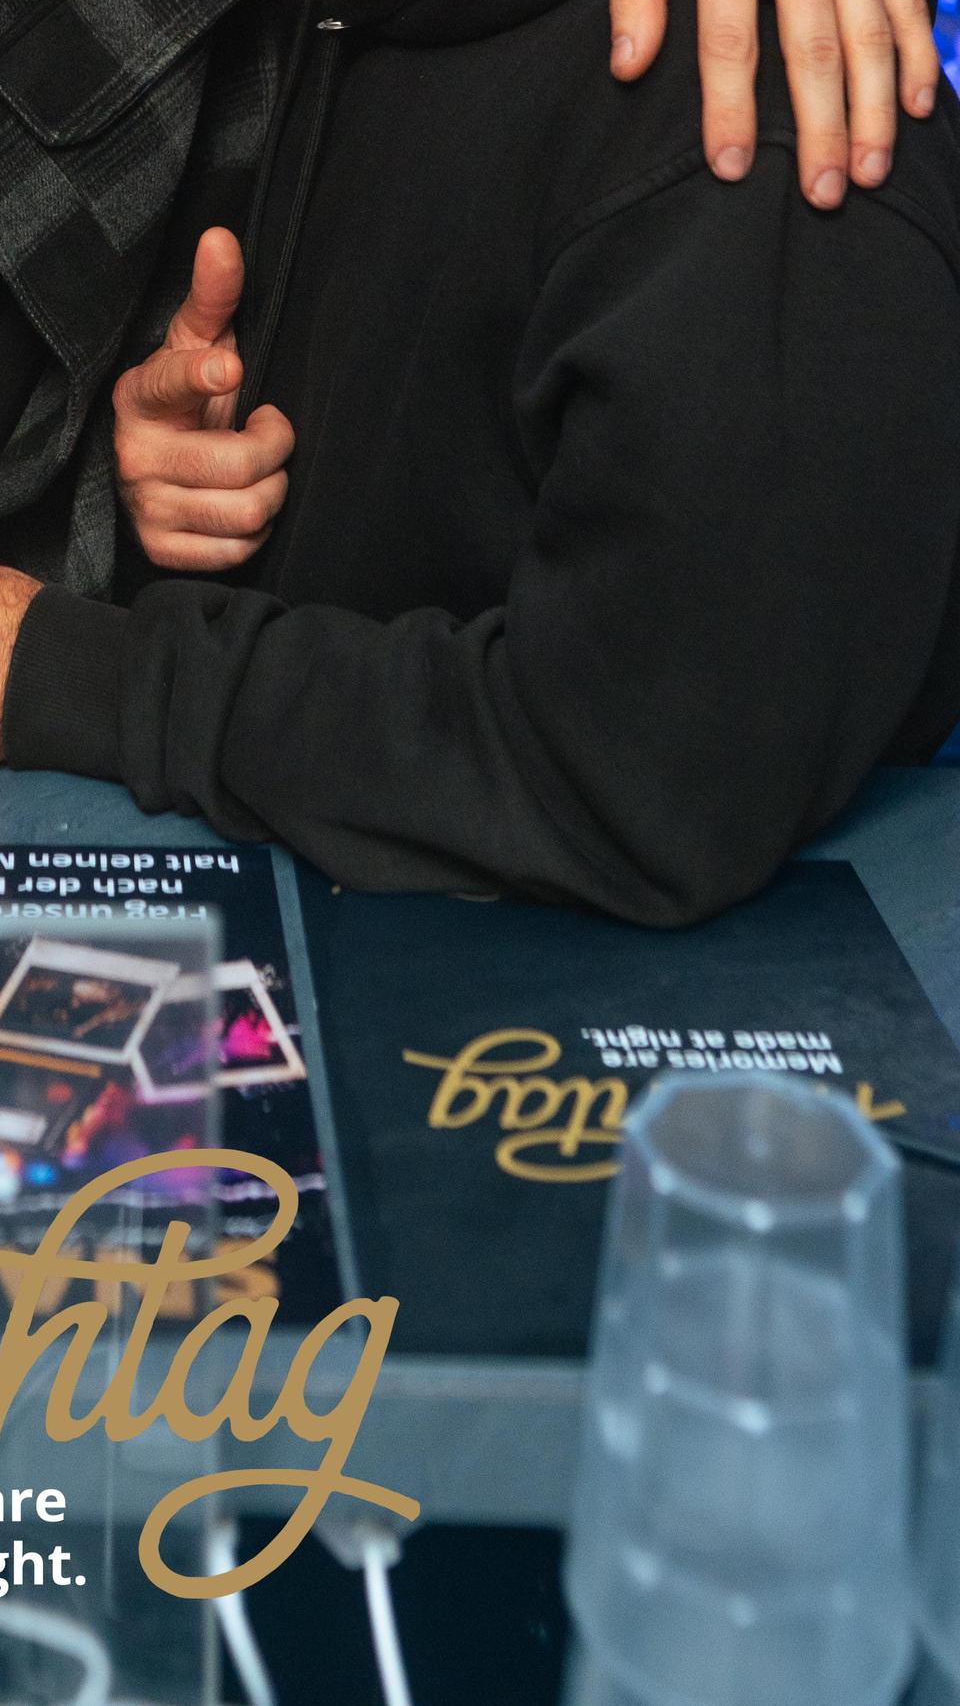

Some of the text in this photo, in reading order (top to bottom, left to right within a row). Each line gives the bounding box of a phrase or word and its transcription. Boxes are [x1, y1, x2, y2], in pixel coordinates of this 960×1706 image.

[28, 852, 155, 873] deinen
[165, 854, 240, 874] halt
[17, 876, 82, 897] der
[92, 877, 184, 898] nach
[581, 1024, 832, 1053] made at night.
[600, 1047, 844, 1075] Memories are
